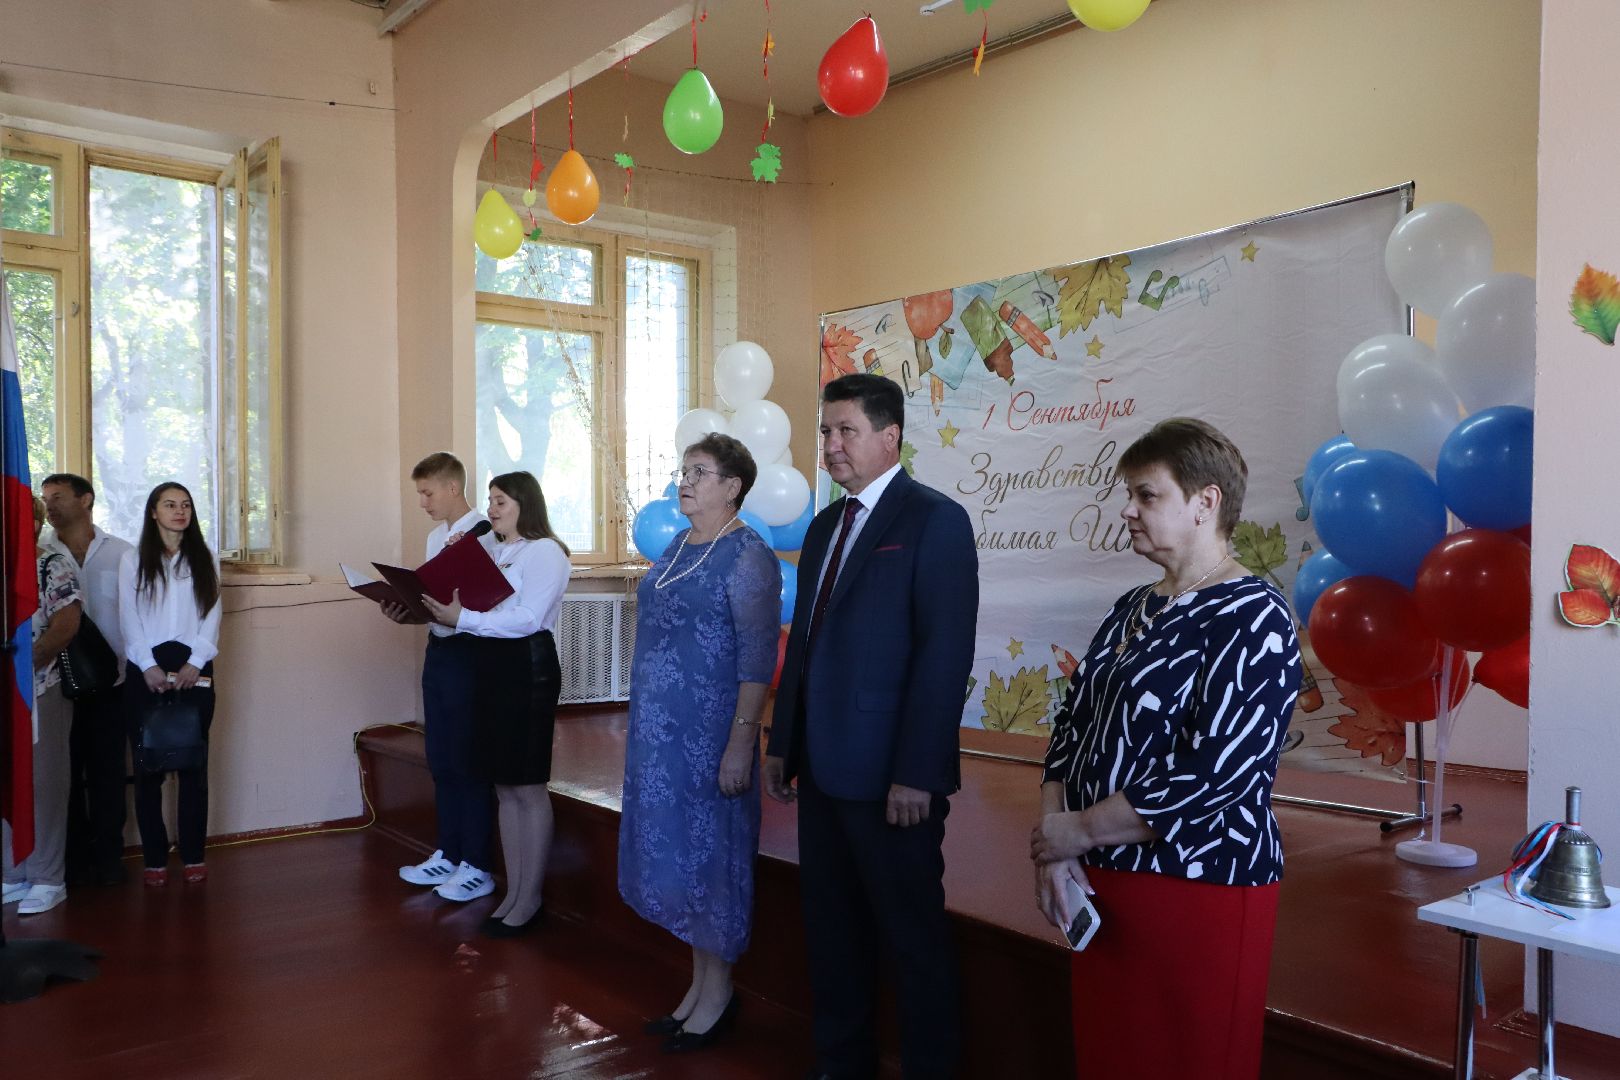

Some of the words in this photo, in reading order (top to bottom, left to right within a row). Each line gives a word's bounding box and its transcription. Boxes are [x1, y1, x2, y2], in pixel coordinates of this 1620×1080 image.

[982, 403, 996, 430] 1
[1008, 378, 1136, 431] Сентября
[957, 440, 1127, 506] Здравству
[976, 508, 1059, 550] бимая
